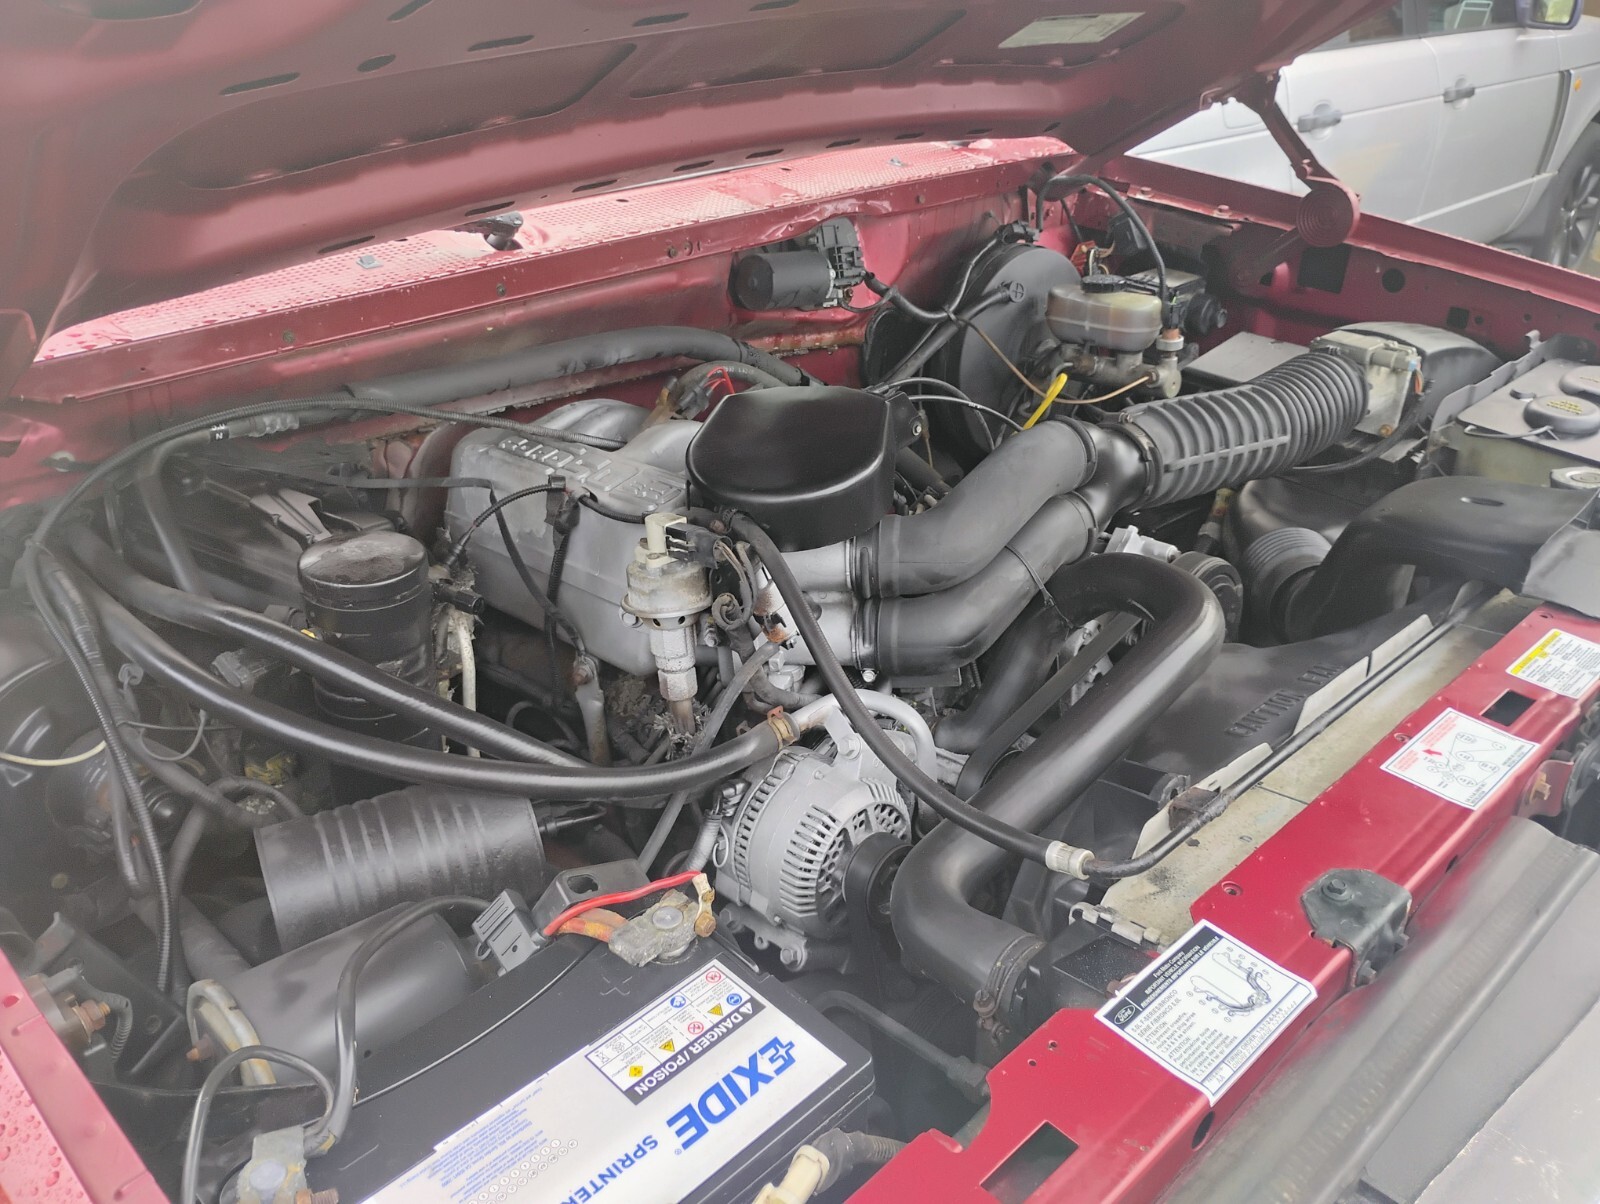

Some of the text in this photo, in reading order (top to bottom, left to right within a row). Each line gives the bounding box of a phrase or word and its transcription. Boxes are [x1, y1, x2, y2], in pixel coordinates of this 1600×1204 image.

[1225, 665, 1344, 737] CAUTION FAN
[1144, 944, 1200, 994] IMPORTANT VEHICLE INFORMATION
[689, 1012, 743, 1055] DANGER
[1115, 1006, 1133, 1022] Ford
[1154, 1026, 1171, 1041] prevent
[1226, 1048, 1242, 1065] FIRING
[667, 1036, 796, 1150] EXIDE
